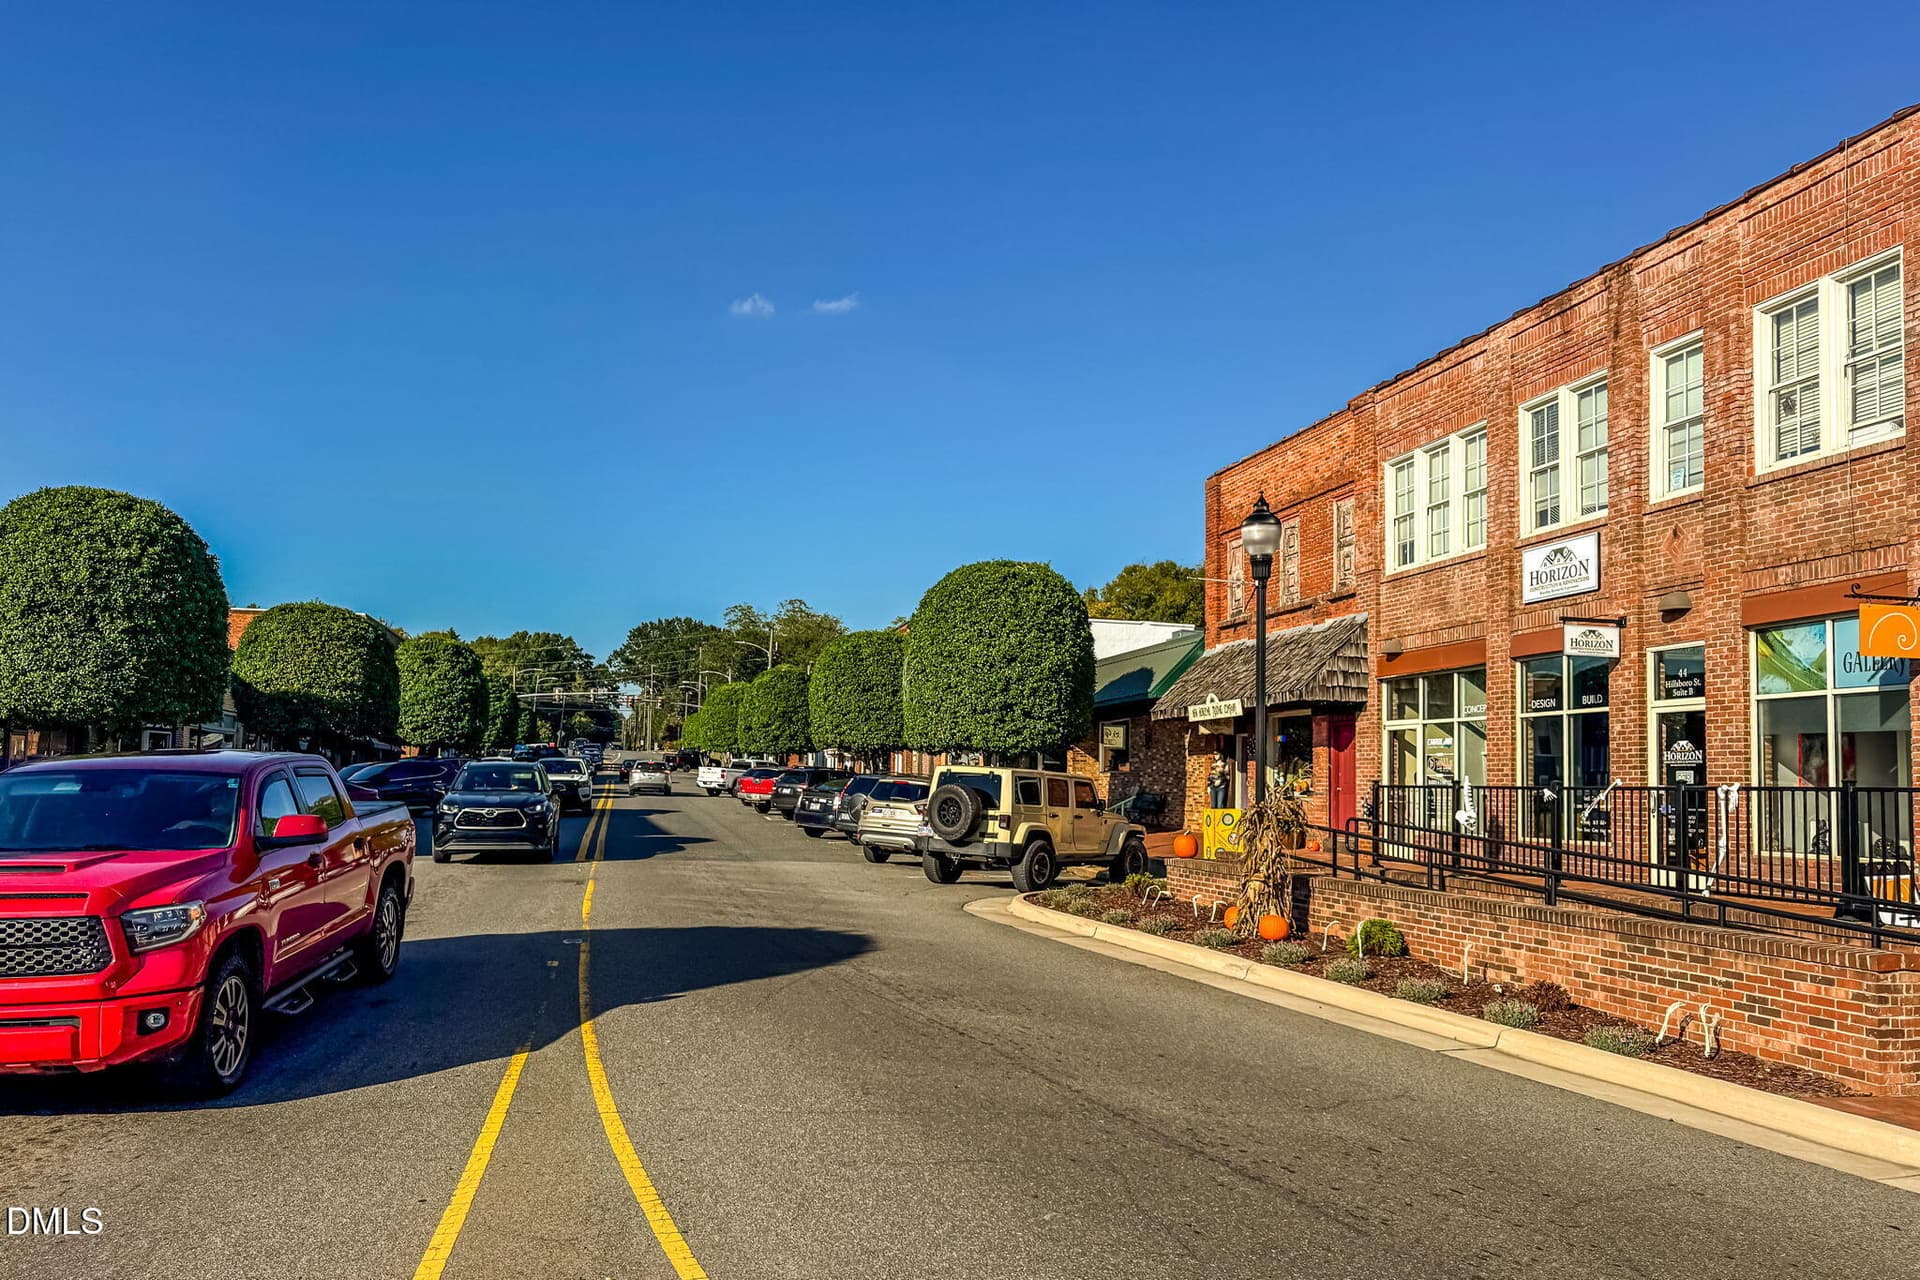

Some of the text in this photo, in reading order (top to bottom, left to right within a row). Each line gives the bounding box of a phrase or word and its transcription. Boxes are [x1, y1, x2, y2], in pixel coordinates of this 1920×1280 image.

[1529, 559, 1590, 587] HORIZON
[1570, 637, 1614, 649] HORIZON
[1678, 668, 1688, 678] 44
[1665, 679, 1693, 689] Hillsboro
[1672, 688, 1688, 697] Suite
[1531, 698, 1556, 709] DESIGN
[1582, 694, 1603, 705] BUILD
[1464, 704, 1487, 714] CONCEP
[1664, 750, 1703, 761] HORIZON
